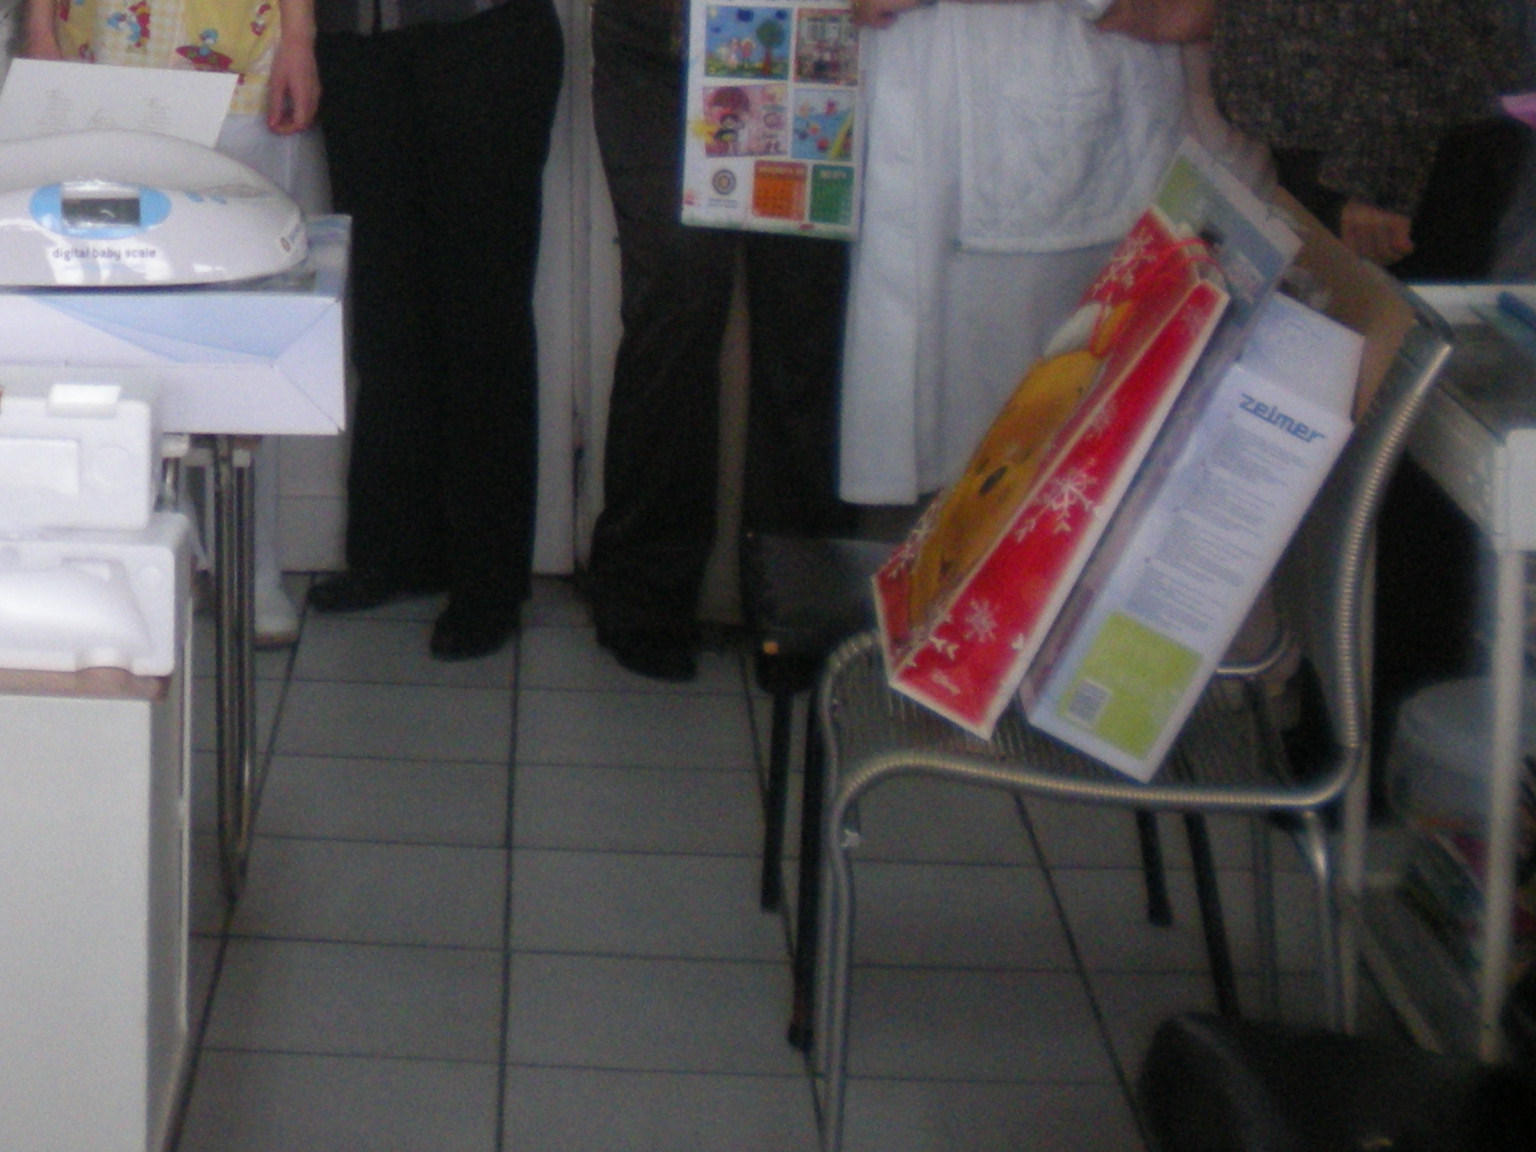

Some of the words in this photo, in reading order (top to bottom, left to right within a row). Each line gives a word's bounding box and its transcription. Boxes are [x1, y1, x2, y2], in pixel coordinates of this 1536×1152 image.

[52, 248, 89, 261] digital
[92, 248, 121, 261] baby
[125, 248, 156, 258] scale
[1239, 391, 1326, 444] zelmer
